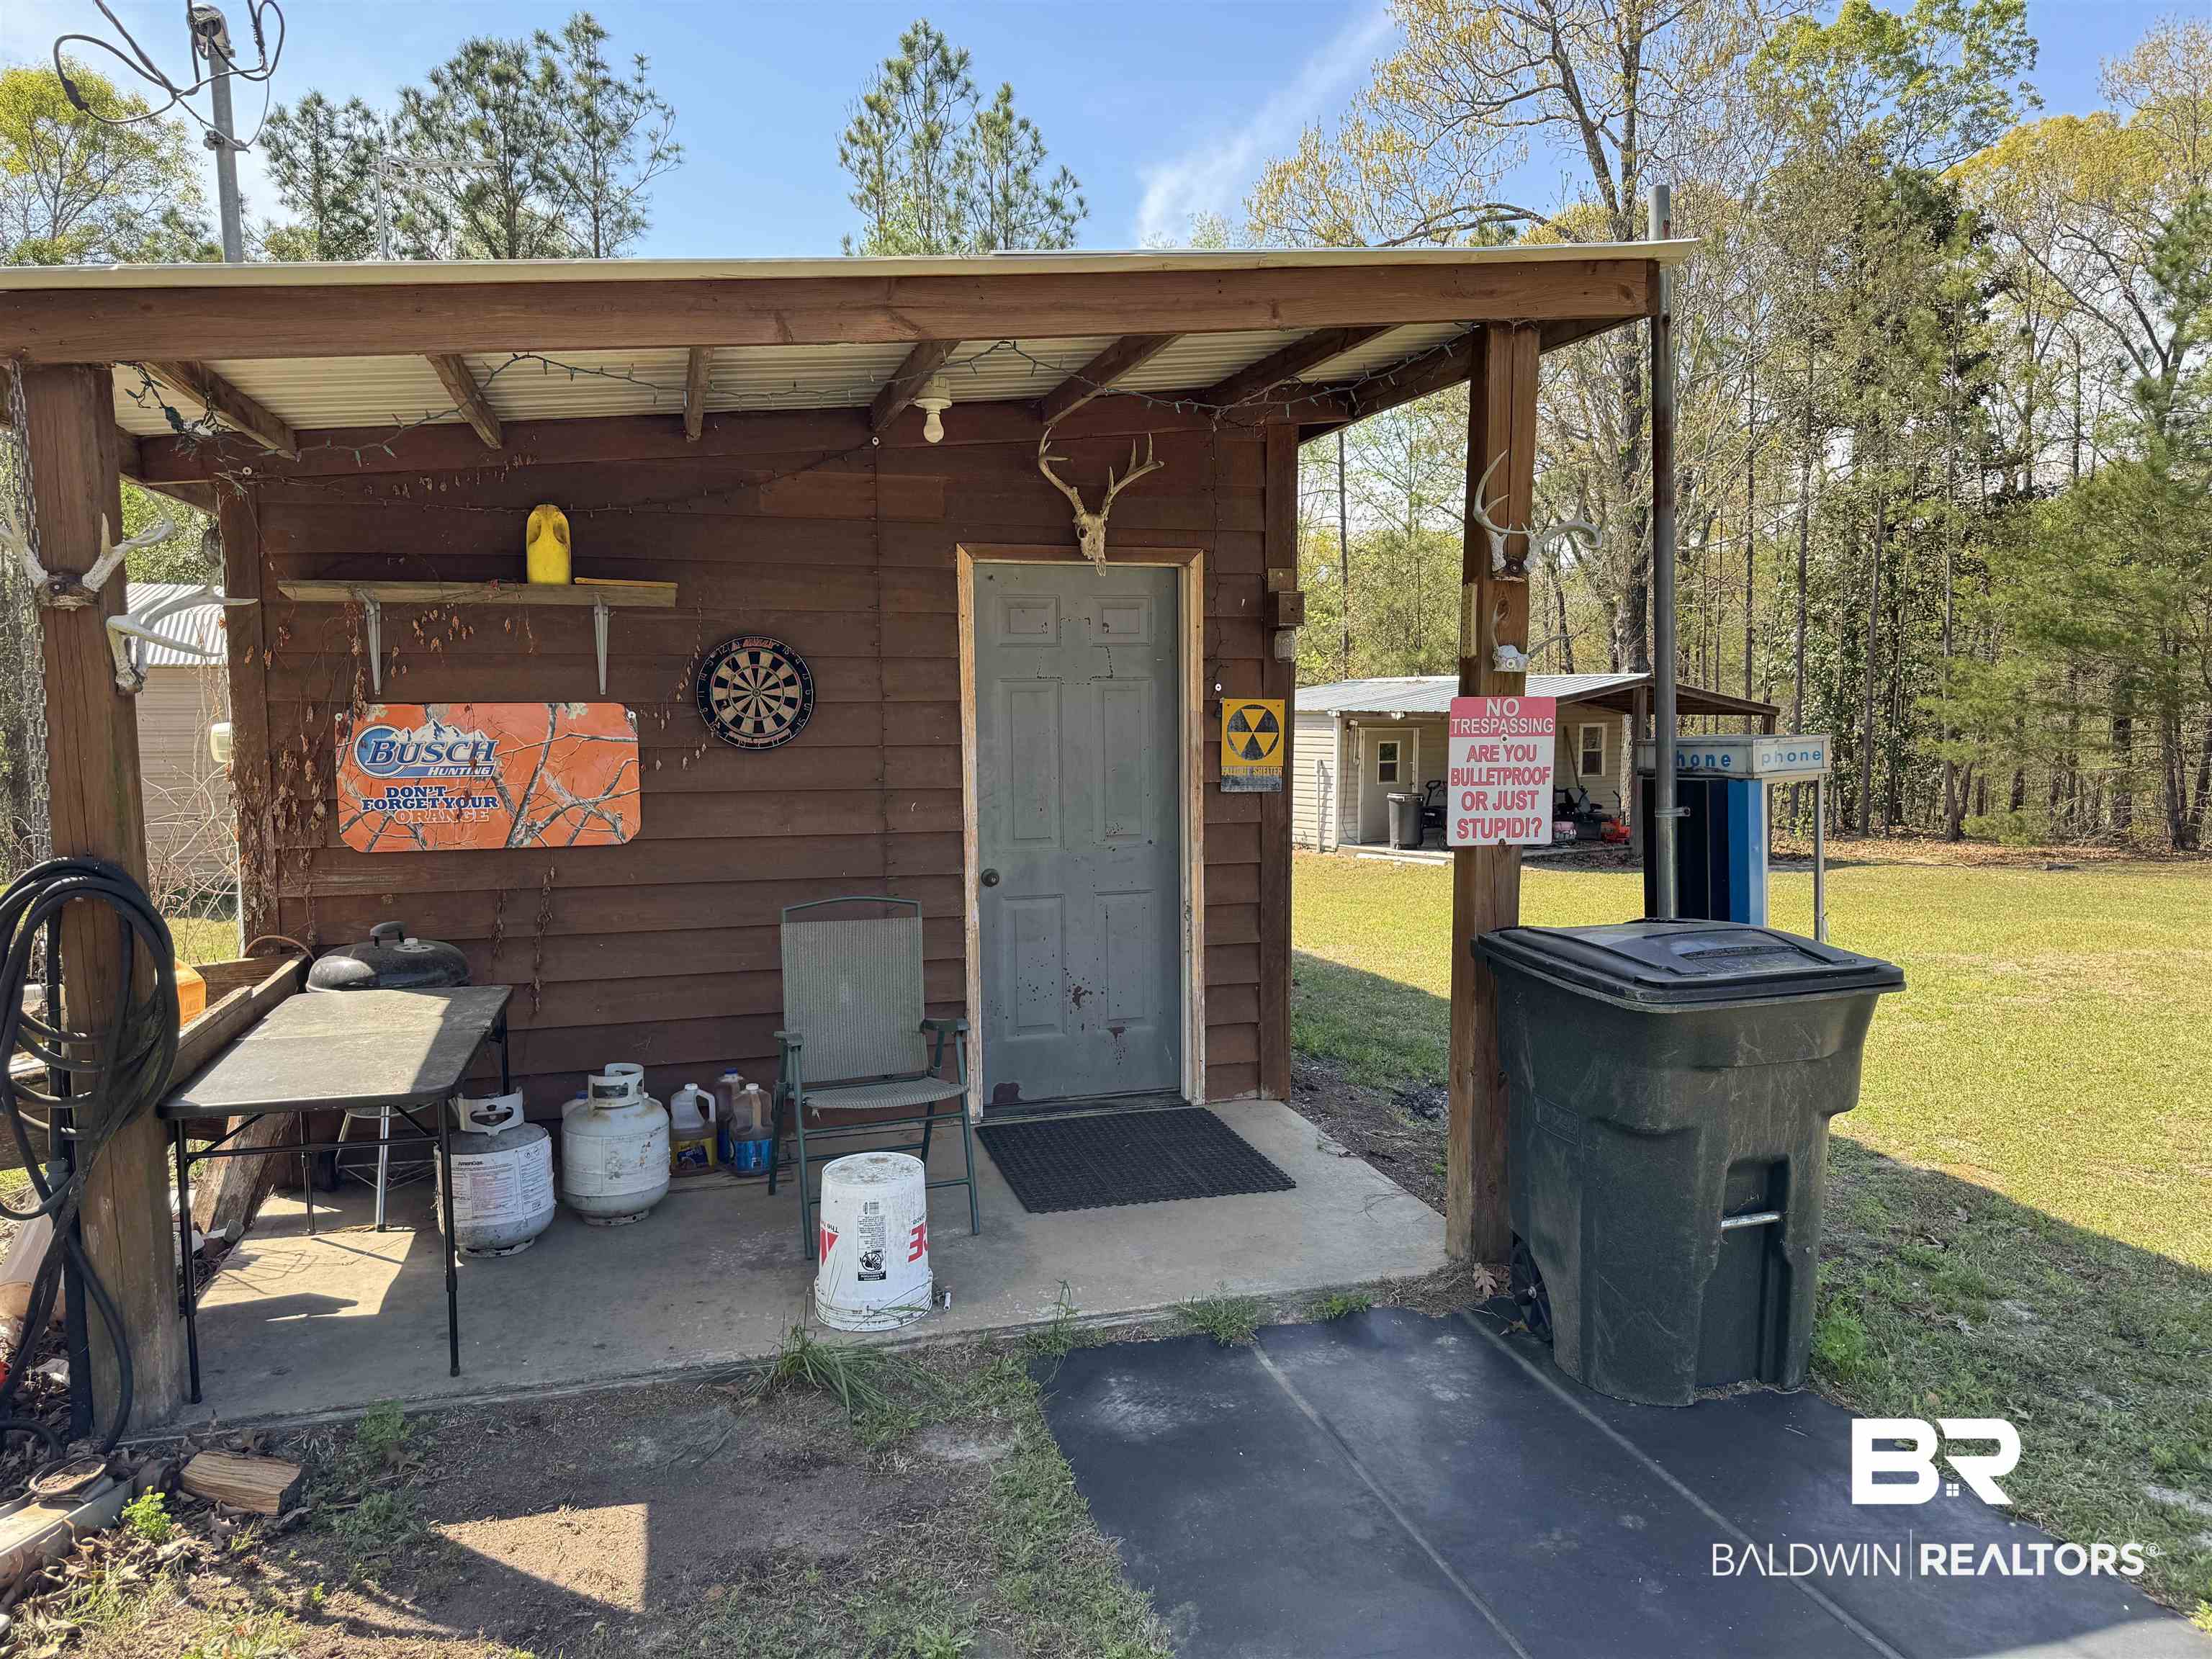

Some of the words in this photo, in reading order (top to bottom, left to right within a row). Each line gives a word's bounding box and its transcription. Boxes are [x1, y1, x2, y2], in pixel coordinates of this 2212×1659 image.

[1485, 698, 1520, 718] NO
[1452, 717, 1554, 734] TRESPASSING
[367, 739, 500, 765] BUSCH
[1466, 745, 1500, 763] ARE
[1503, 744, 1537, 763] YOU
[1676, 750, 1732, 768] hone
[1761, 748, 1822, 767] phone
[427, 766, 491, 776] HUNTING
[1253, 766, 1282, 775] SHELTER
[1451, 767, 1551, 787] BULLETPROOF
[385, 786, 447, 799] DON'T
[1462, 791, 1489, 811] OR
[1492, 790, 1539, 811] JUST
[361, 797, 439, 811] FORGET
[442, 796, 499, 810] YOUR
[394, 808, 490, 824] ORANGE
[1456, 817, 1543, 840] STUPID!?
